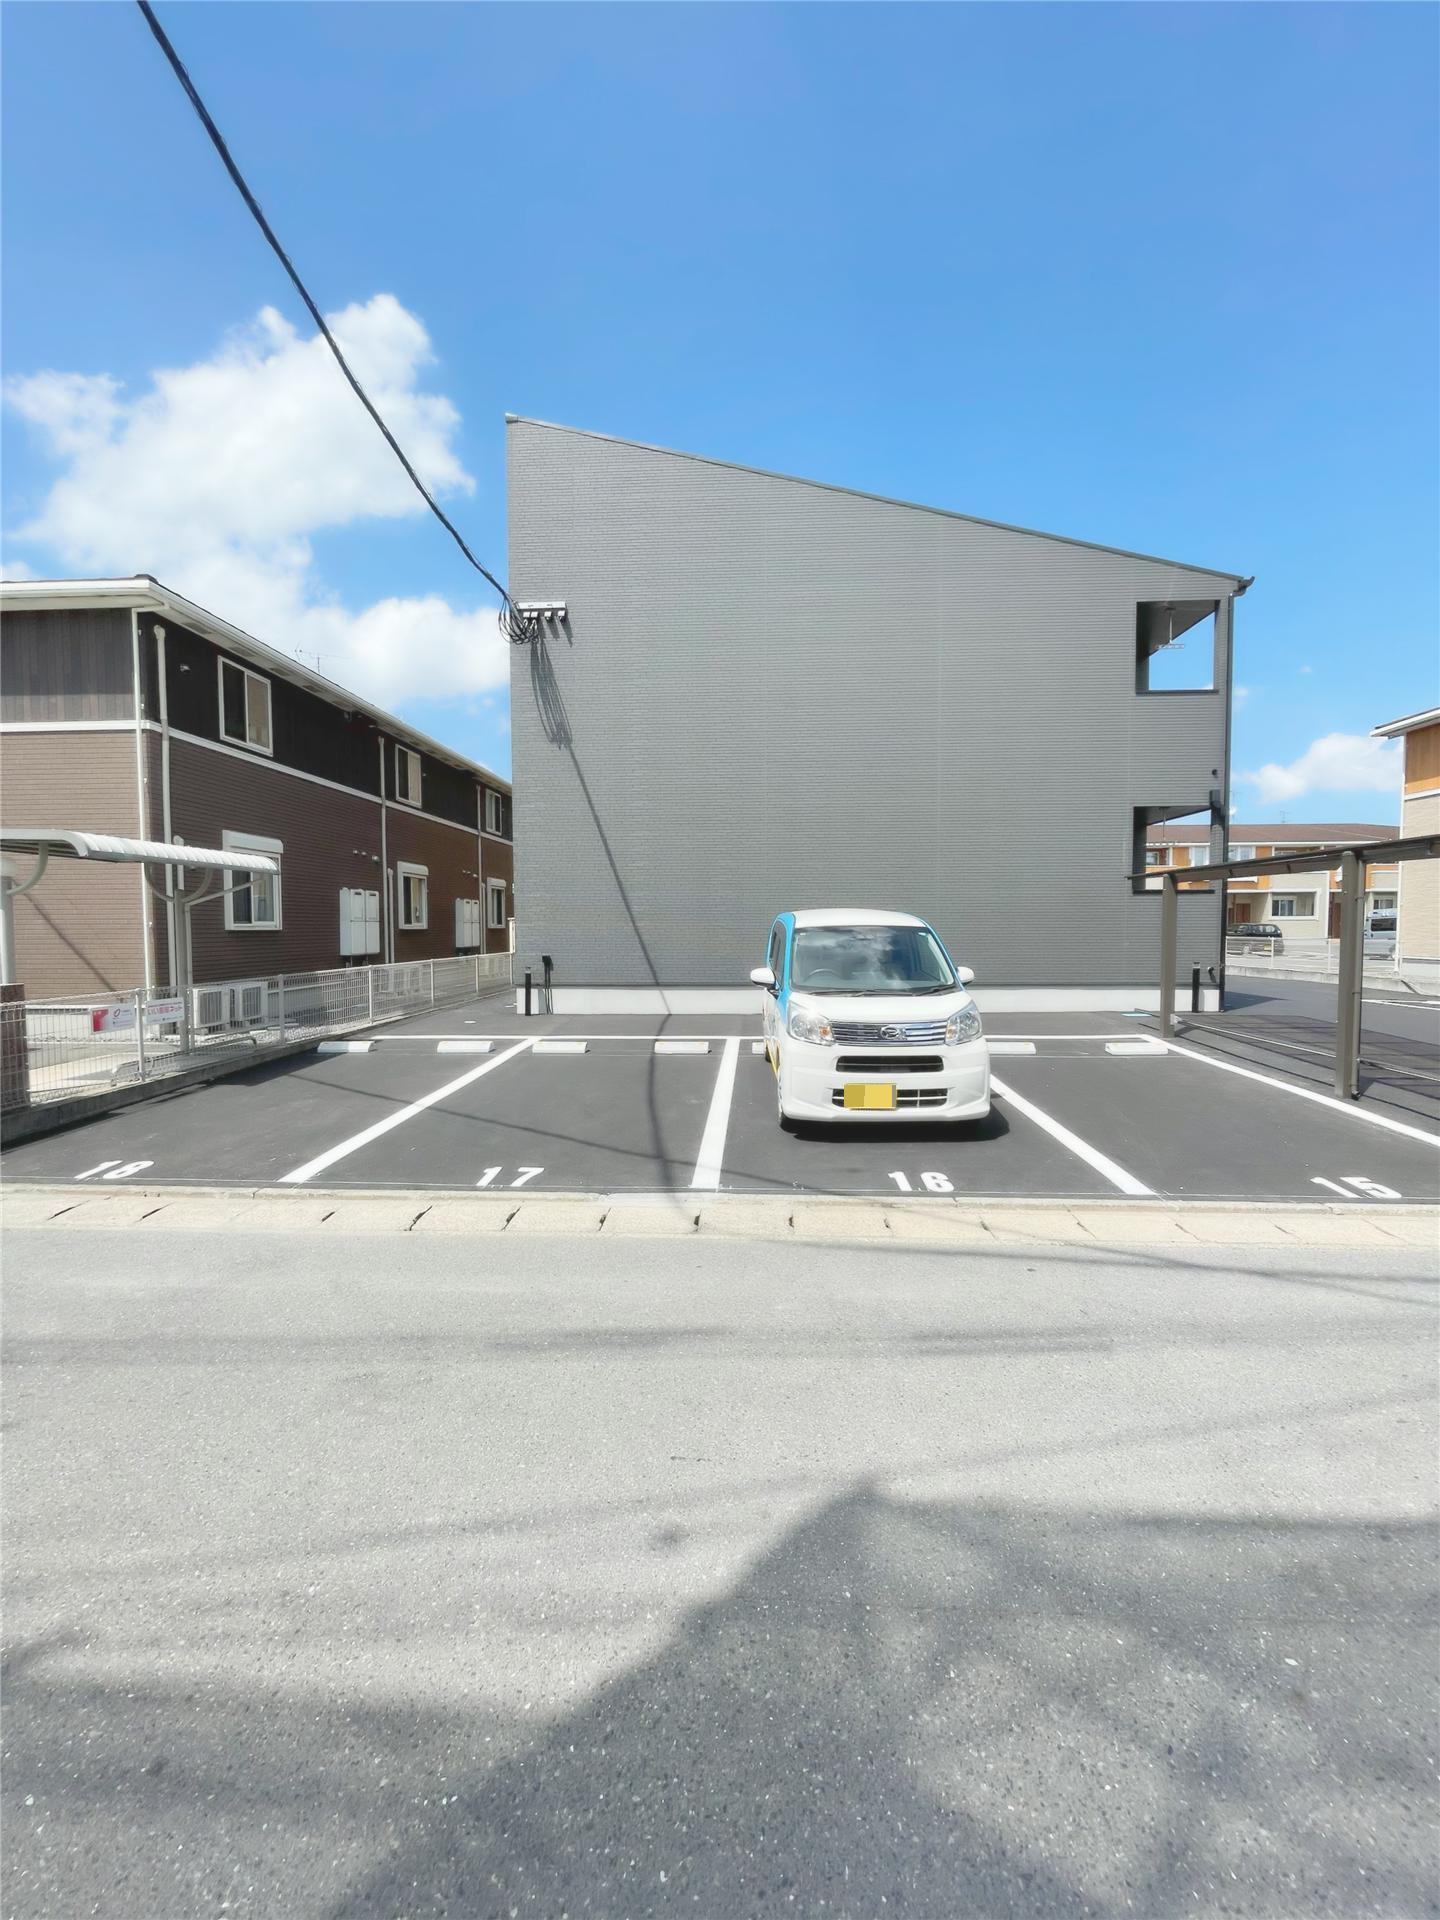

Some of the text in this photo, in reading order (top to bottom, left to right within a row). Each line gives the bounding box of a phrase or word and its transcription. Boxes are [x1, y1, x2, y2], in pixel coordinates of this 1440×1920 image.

[73, 1160, 155, 1180] 18
[475, 1166, 545, 1188] 17
[887, 1171, 955, 1192] 16
[1309, 1176, 1402, 1199] 15
